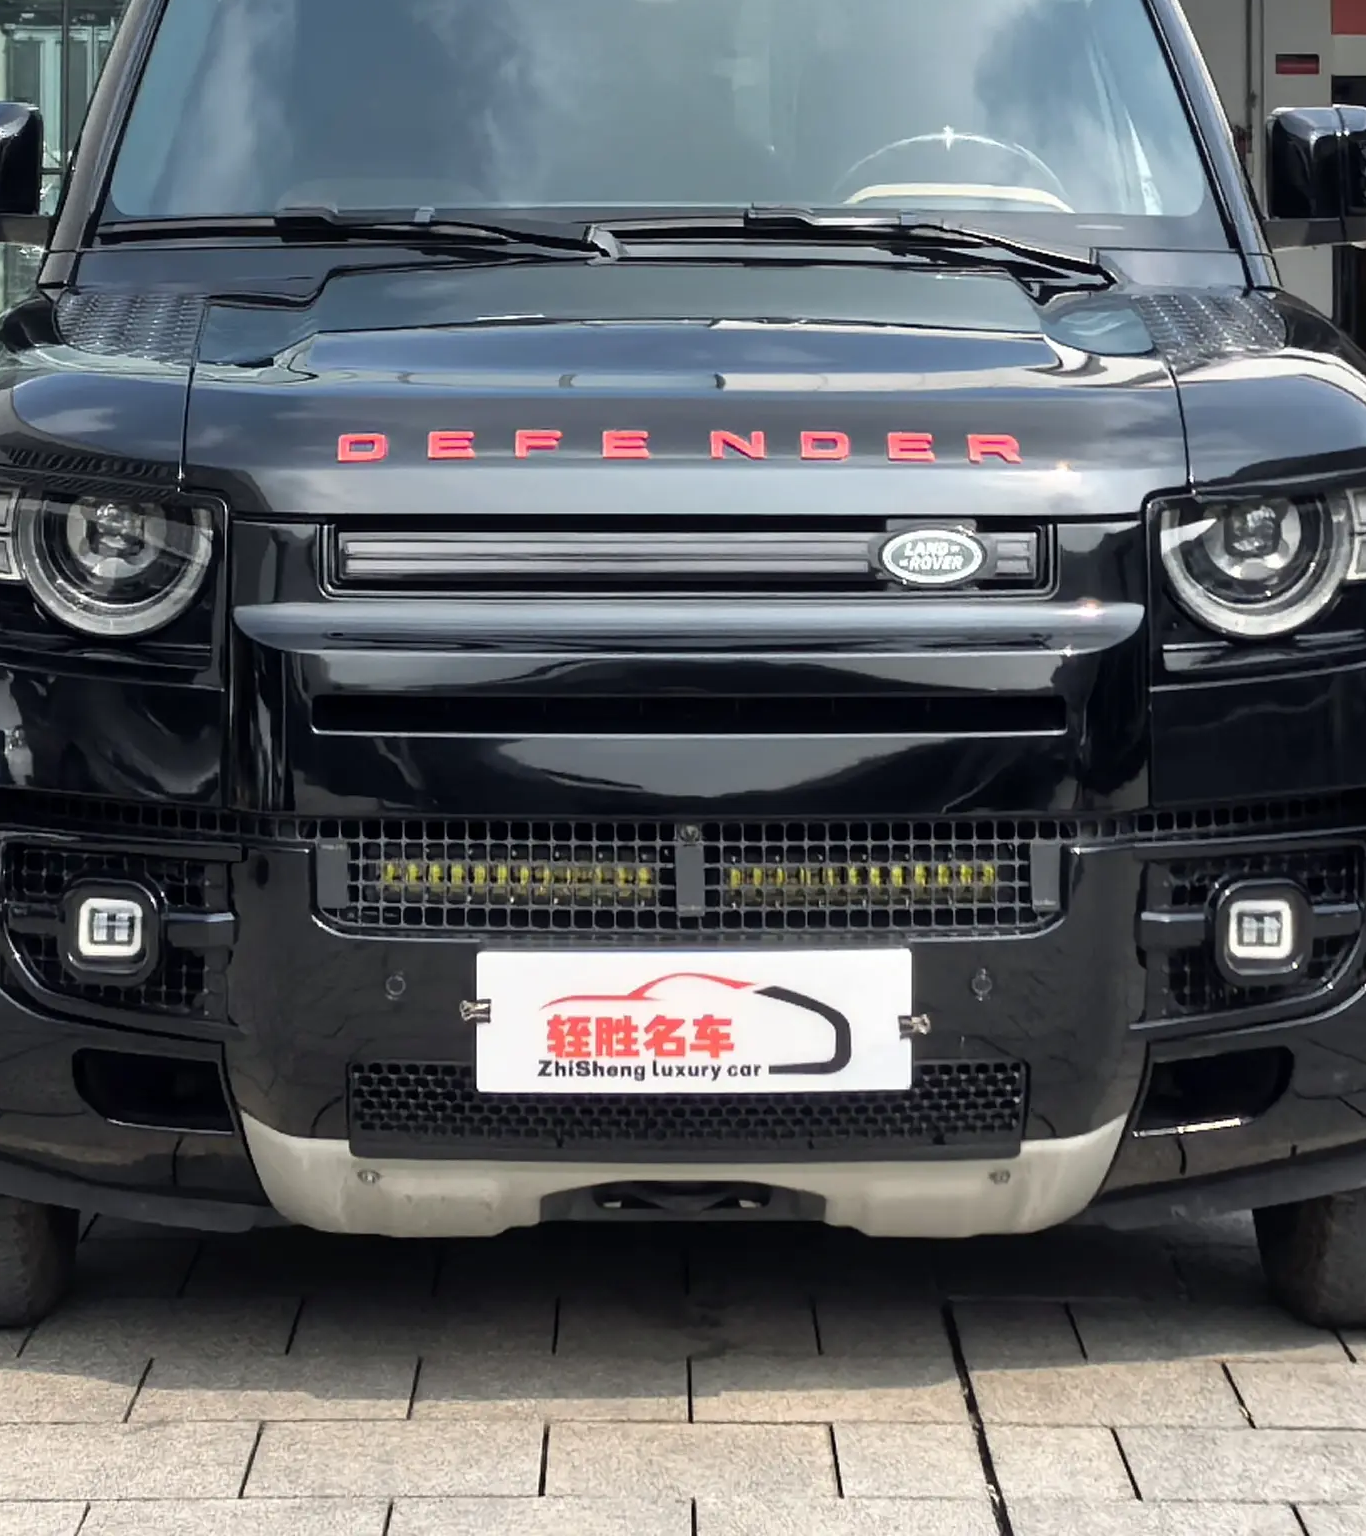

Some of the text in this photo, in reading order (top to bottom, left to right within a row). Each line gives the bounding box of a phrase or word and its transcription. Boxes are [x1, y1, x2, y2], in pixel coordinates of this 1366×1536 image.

[336, 429, 1023, 464] DEFENDER
[904, 542, 949, 556] LAND
[909, 556, 964, 571] ROVER
[537, 1060, 762, 1081] ZhiSheng luxury car
